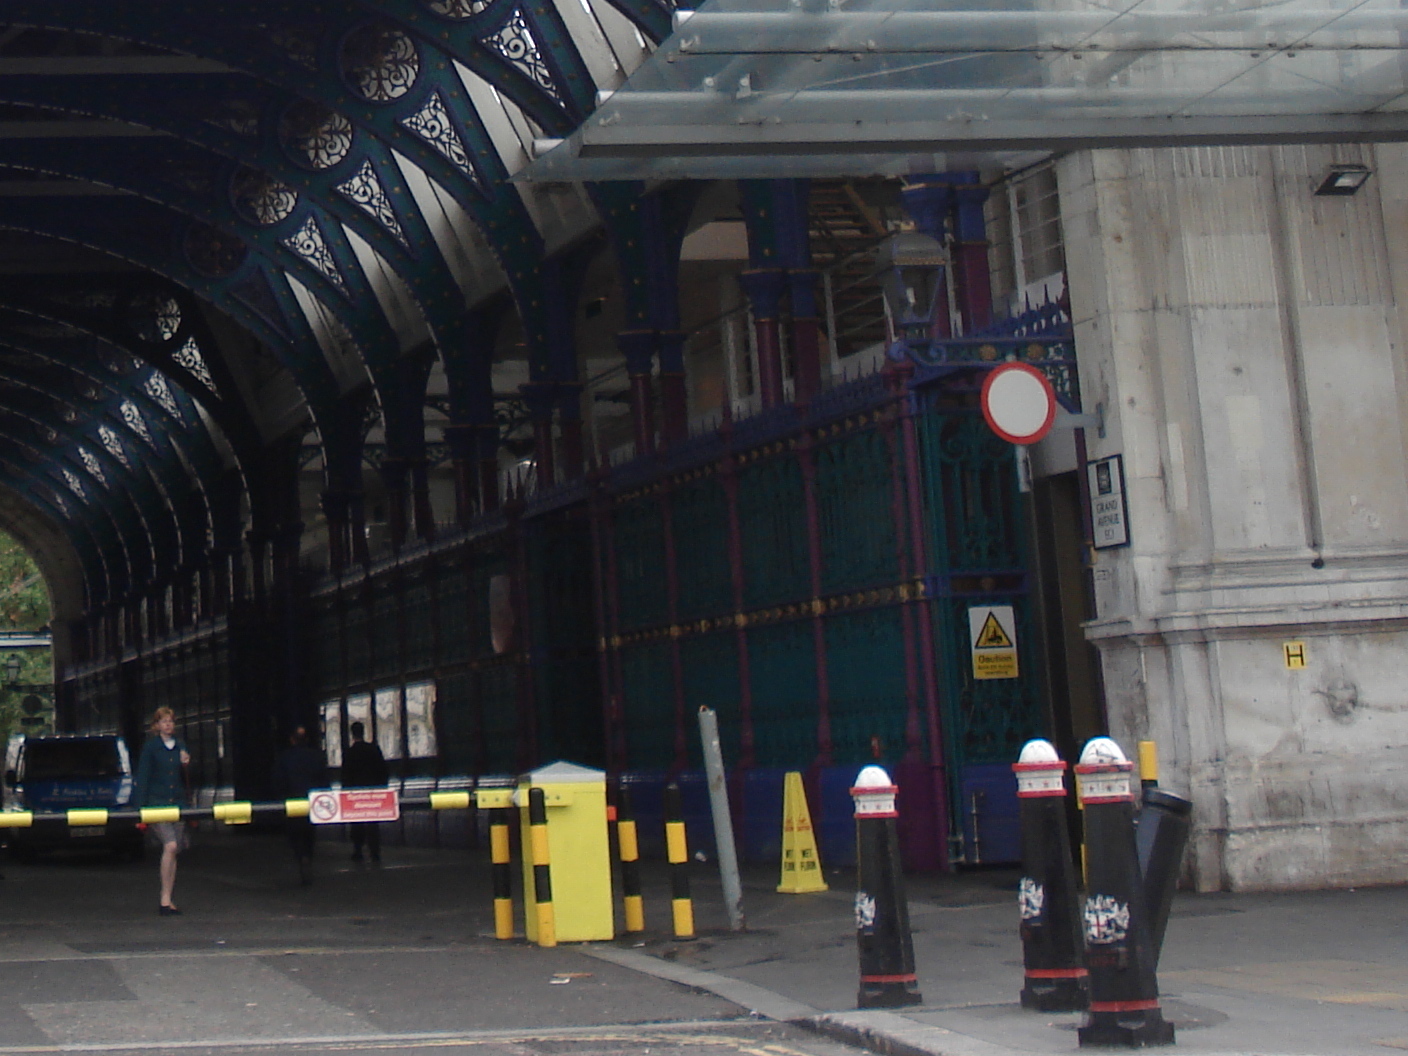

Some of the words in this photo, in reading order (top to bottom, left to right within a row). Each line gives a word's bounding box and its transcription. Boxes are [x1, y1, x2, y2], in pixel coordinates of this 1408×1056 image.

[1096, 500, 1118, 514] GRAND
[1098, 513, 1120, 526] AVENUE
[1286, 644, 1304, 667] H
